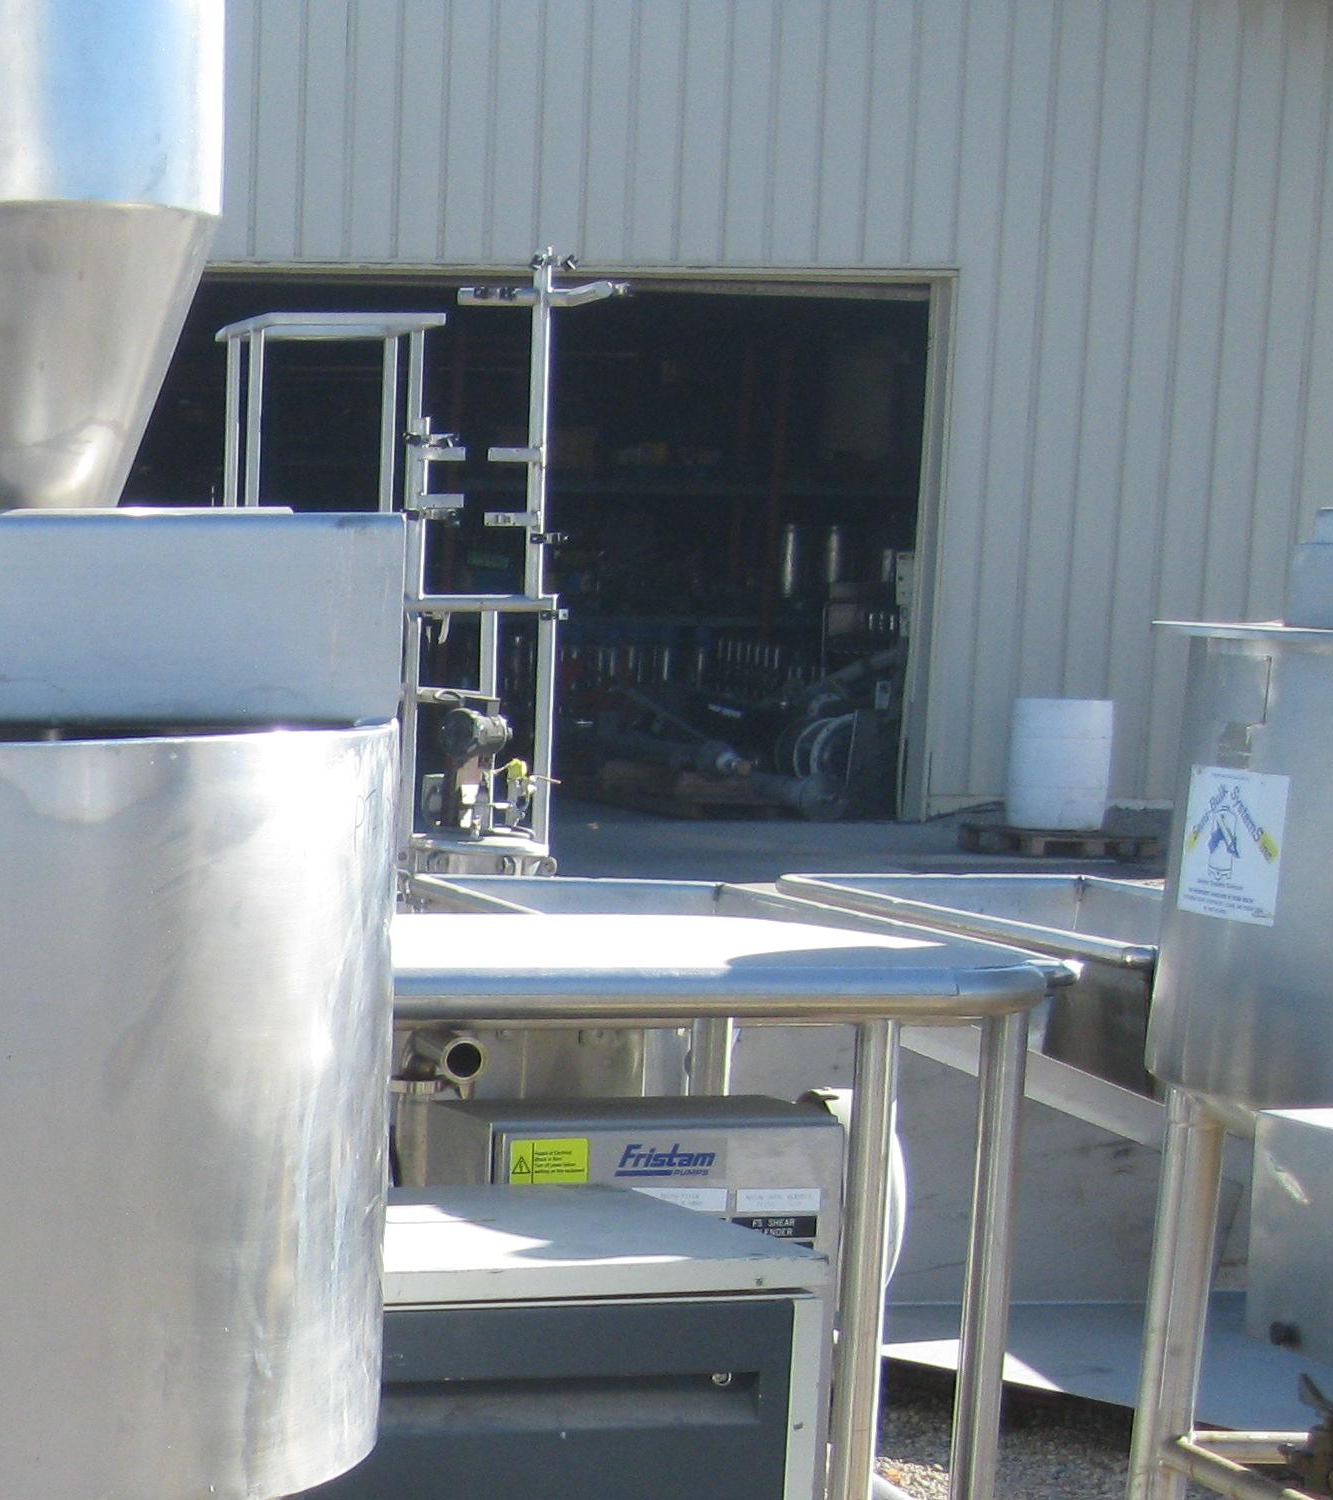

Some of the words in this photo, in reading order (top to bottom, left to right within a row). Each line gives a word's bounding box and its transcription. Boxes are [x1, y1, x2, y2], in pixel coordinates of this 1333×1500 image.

[618, 1143, 716, 1169] Fristam
[672, 1168, 709, 1177] PUMPS
[768, 1217, 795, 1228] SHEAR
